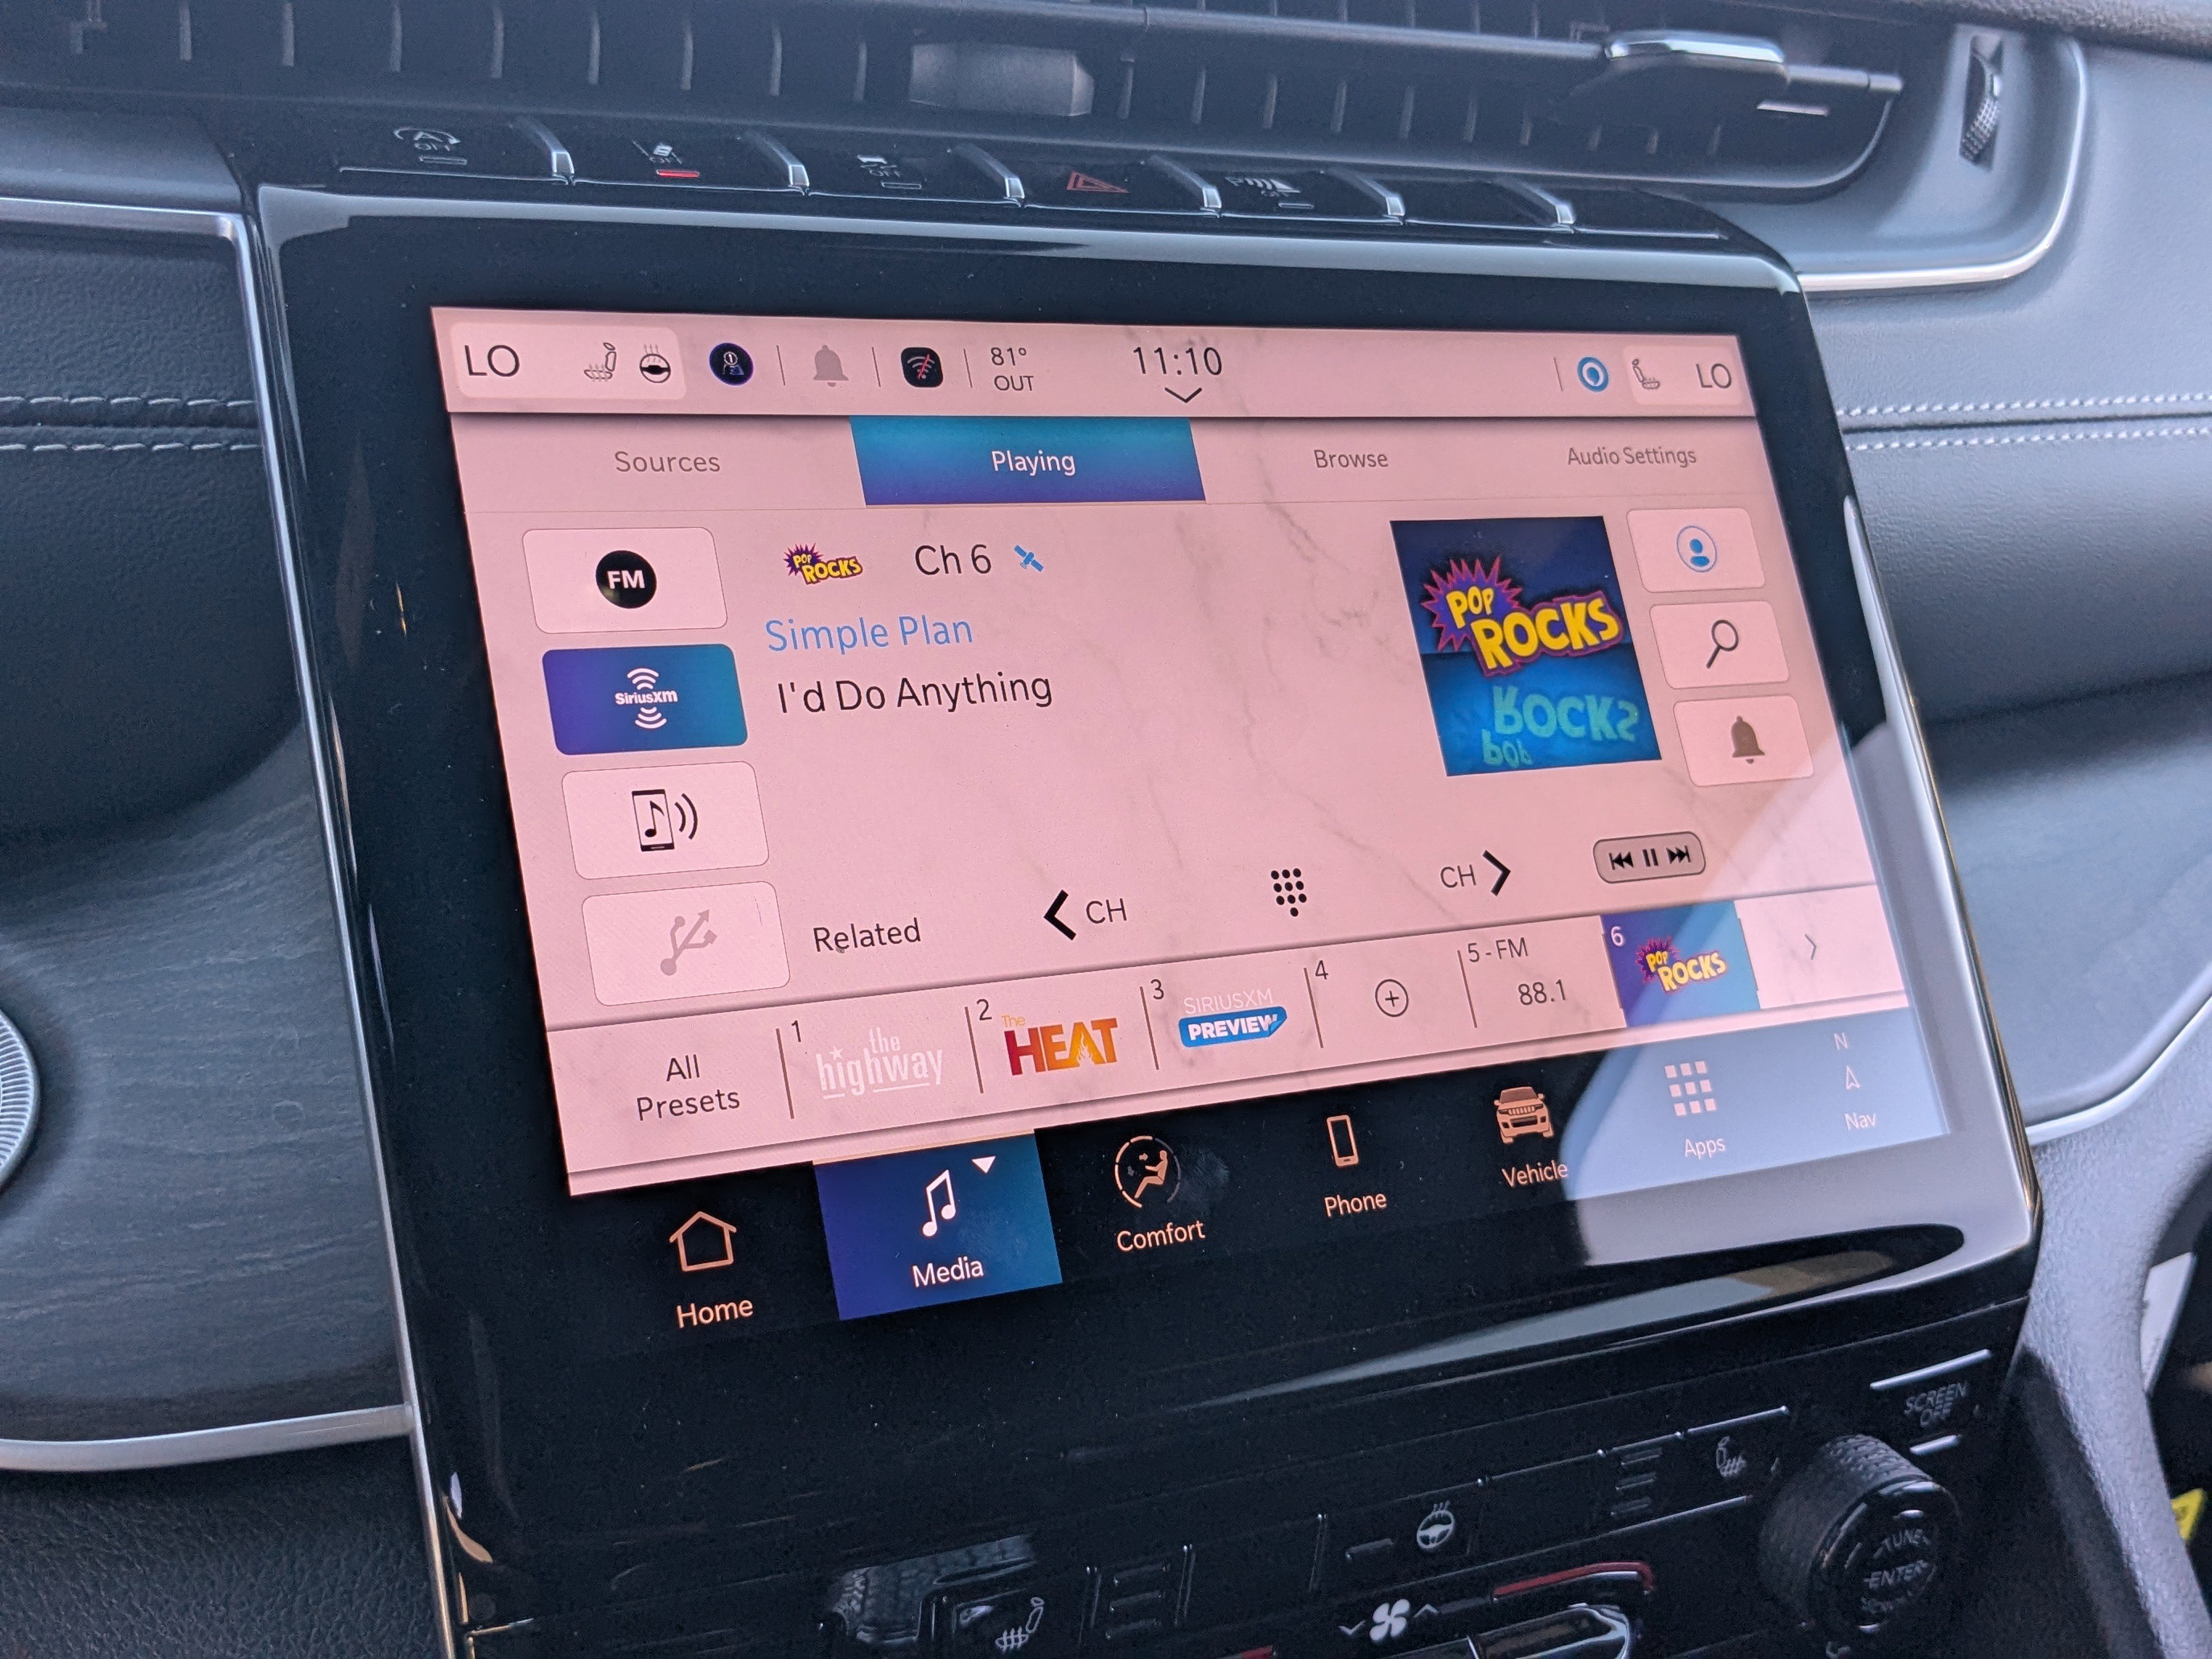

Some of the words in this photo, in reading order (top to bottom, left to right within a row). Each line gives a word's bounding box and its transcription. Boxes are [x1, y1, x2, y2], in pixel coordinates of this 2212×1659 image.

[464, 344, 520, 377] LO
[990, 347, 1028, 366] 81°
[1133, 346, 1223, 376] 11:10
[994, 375, 1034, 392] OUT
[1695, 362, 1733, 390] LO
[615, 451, 721, 473] Sources
[991, 450, 1076, 476] Playing
[1313, 448, 1389, 470] Browse
[1567, 446, 1620, 467] Audio
[1624, 446, 1697, 468] Settings
[792, 552, 812, 569] POP
[802, 557, 862, 583] ROCKS
[915, 544, 962, 575] Ch
[972, 544, 992, 574] 6
[606, 569, 646, 589] FM
[1446, 586, 1494, 629] POP
[765, 617, 889, 656] Simple
[899, 616, 973, 645] Plan
[1470, 597, 1620, 670] ROCKS
[777, 682, 825, 713] I'd
[836, 680, 885, 709] Do
[897, 672, 1052, 711] Anything
[1440, 865, 1476, 889] CH
[1086, 898, 1127, 924] CH
[813, 917, 922, 952] Related
[1610, 926, 1624, 946] 6
[1314, 960, 1329, 981] 4
[1646, 949, 1667, 972] POP
[1658, 951, 1726, 991] ROCKS
[1150, 979, 1165, 1000] 3
[1184, 988, 1273, 1014] SIRIUSXM
[1518, 979, 1566, 1005] 88.1
[977, 999, 992, 1021] 2
[1001, 1014, 1025, 1028] The
[792, 1020, 803, 1042] 1
[869, 1026, 900, 1052] the
[1188, 1014, 1278, 1041] PREVIEW
[1004, 1018, 1118, 1075] HEAT
[1835, 1034, 1848, 1050] N
[666, 1054, 701, 1081] All
[817, 1048, 943, 1095] highway
[637, 1088, 740, 1121] Presets
[1845, 1111, 1877, 1131] Nav
[1684, 1136, 1726, 1159] Apps
[1502, 1160, 1568, 1187] Vehicle
[1325, 1192, 1386, 1217] Phone
[1116, 1221, 1205, 1252] Comfort
[913, 1257, 984, 1288] Media
[677, 1297, 754, 1328] Home
[1904, 1383, 1968, 1415] SCREEN
